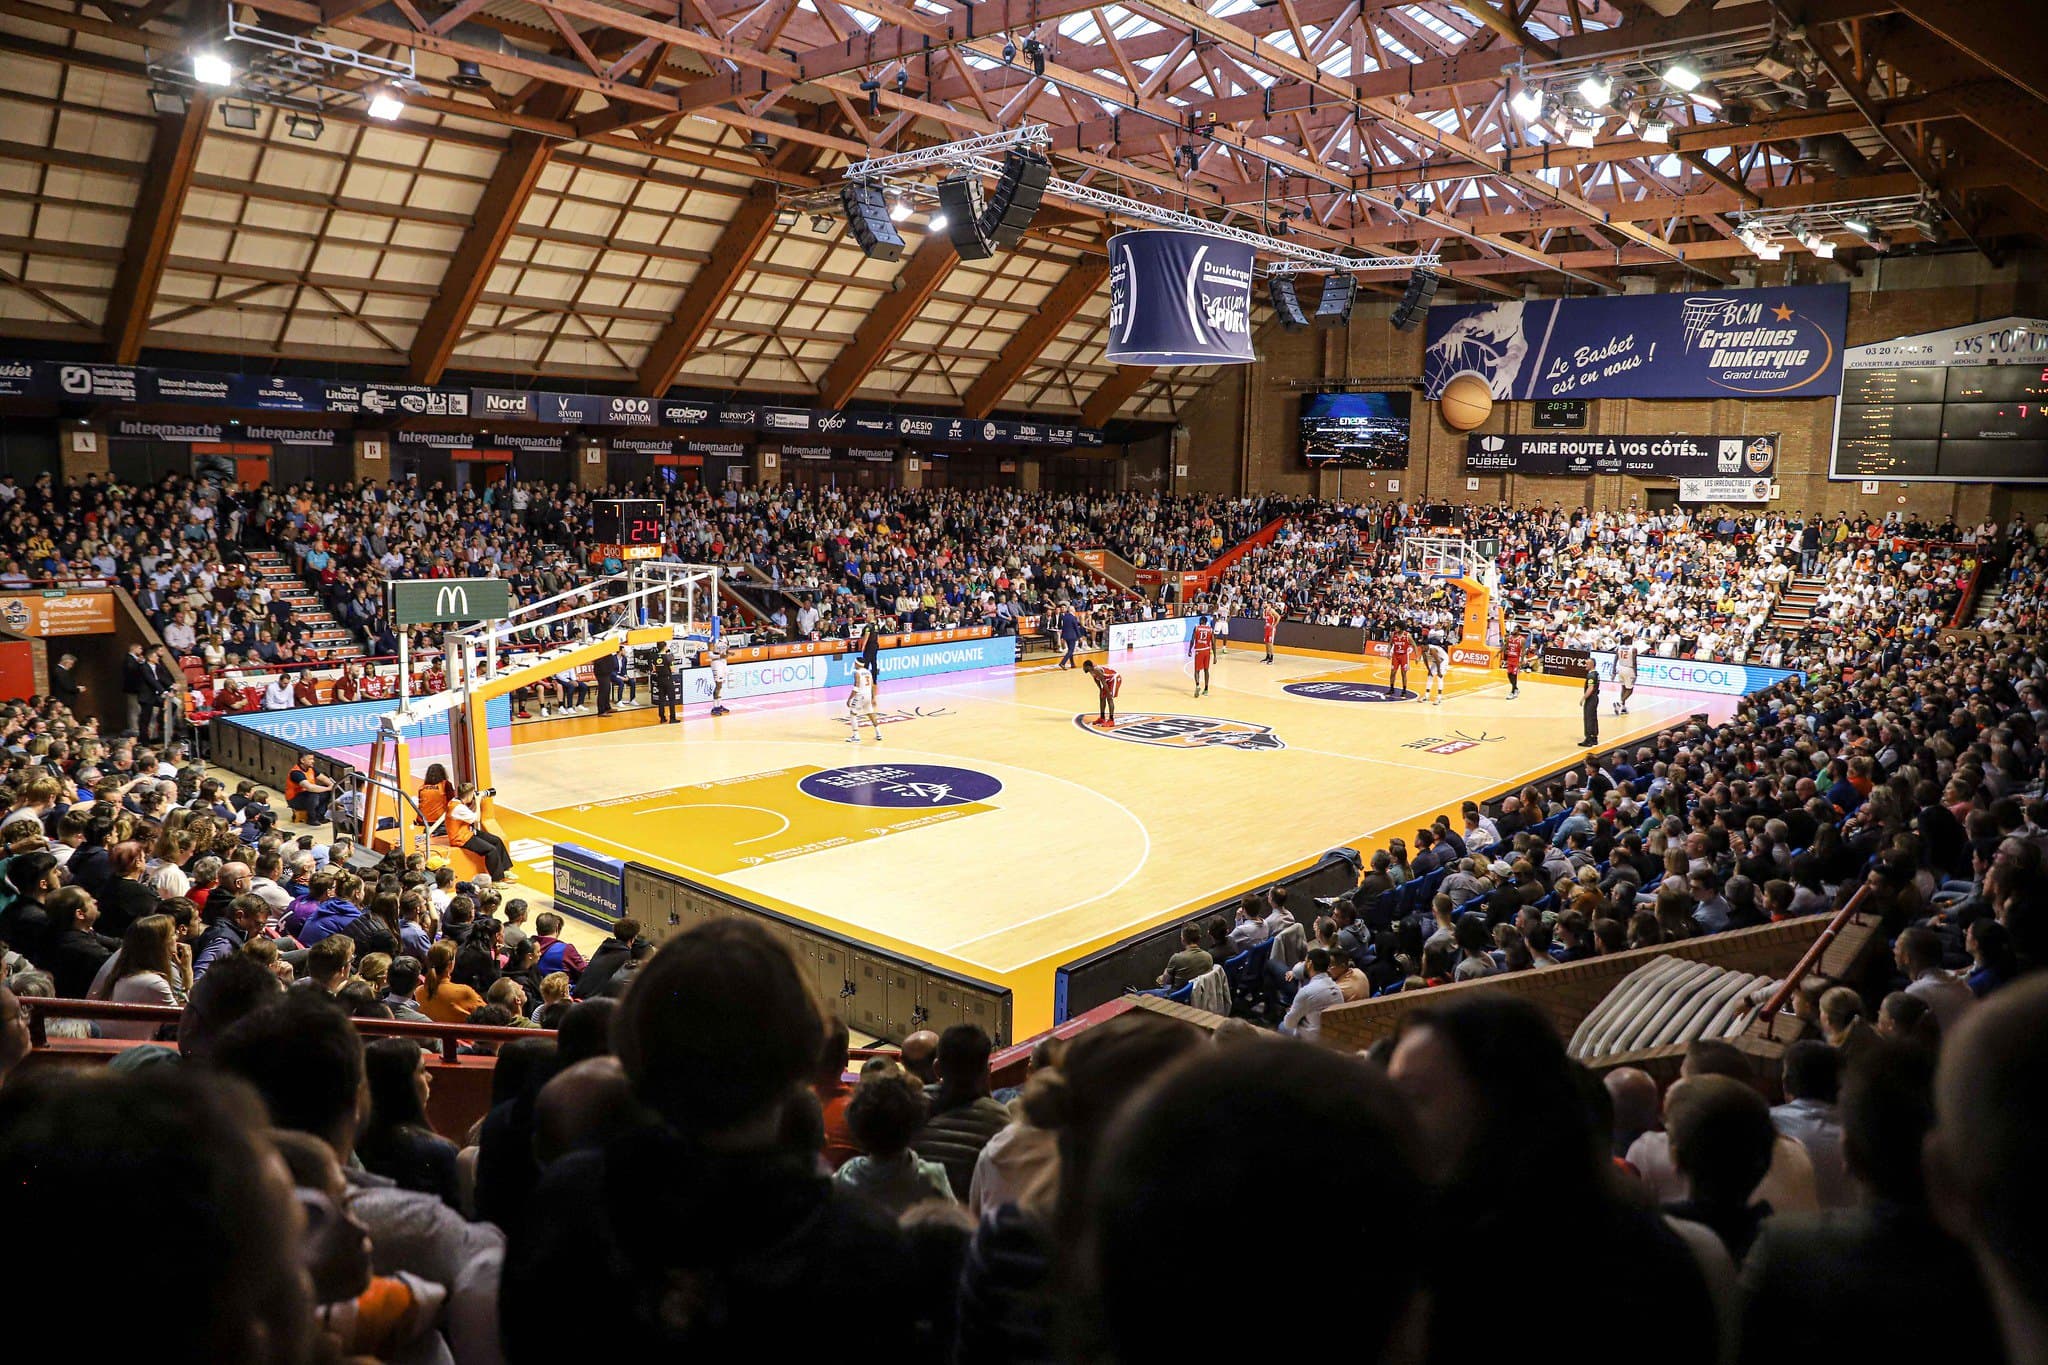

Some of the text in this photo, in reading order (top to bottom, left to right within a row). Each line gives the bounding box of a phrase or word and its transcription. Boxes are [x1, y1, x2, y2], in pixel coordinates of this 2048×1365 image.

[1204, 262, 1249, 281] Dunkerque
[1207, 304, 1246, 333] SPORT
[1722, 302, 1763, 327] BCM
[1698, 326, 1798, 351] Gravelines
[1879, 347, 1891, 355] 20
[1922, 345, 1933, 353] 76
[1546, 333, 1633, 380] Le Basket
[1709, 347, 1810, 369] Dunkerque
[1850, 360, 1893, 368] COUVERTURE
[1901, 359, 1936, 367] ZINGUERIE
[1550, 375, 1575, 397] est
[1579, 370, 1599, 387] en
[1603, 355, 1642, 381] nous
[1722, 368, 1788, 382] Grand Littoral
[258, 389, 299, 398] EUROVIA
[366, 383, 431, 393] PARTENAIRES MÉDIAS
[326, 389, 360, 401] Littoral
[332, 401, 360, 413] Phare
[486, 394, 527, 410] Nord
[1547, 402, 1574, 411] 20:37
[557, 409, 583, 419] sivom
[719, 411, 748, 420] DUPONT
[2017, 405, 2028, 418] 7
[608, 412, 651, 424] SANITATION
[120, 420, 222, 436] Intermarché
[247, 426, 336, 441] Intermarché
[948, 429, 962, 437] STC
[82, 437, 90, 448] A
[398, 431, 474, 443] Intermarché
[494, 434, 563, 447] Intermarché
[368, 444, 376, 455] B
[612, 438, 673, 450] Intermarché
[688, 441, 744, 453] Intermarché
[782, 444, 832, 456] Intermarché
[1521, 440, 1709, 457] FAIRE ROUTE À VOS CÔTÉS...
[847, 447, 894, 458] Intermarché
[1749, 452, 1769, 462] BCM
[631, 520, 659, 541] 24
[922, 647, 985, 667] INNOVANTE
[1544, 654, 1577, 666] BECITY
[1619, 650, 1630, 660] 12
[1462, 659, 1488, 667] MUTUELLE
[425, 784, 440, 792] EDIA
[569, 884, 617, 911] Hauts-de-France
